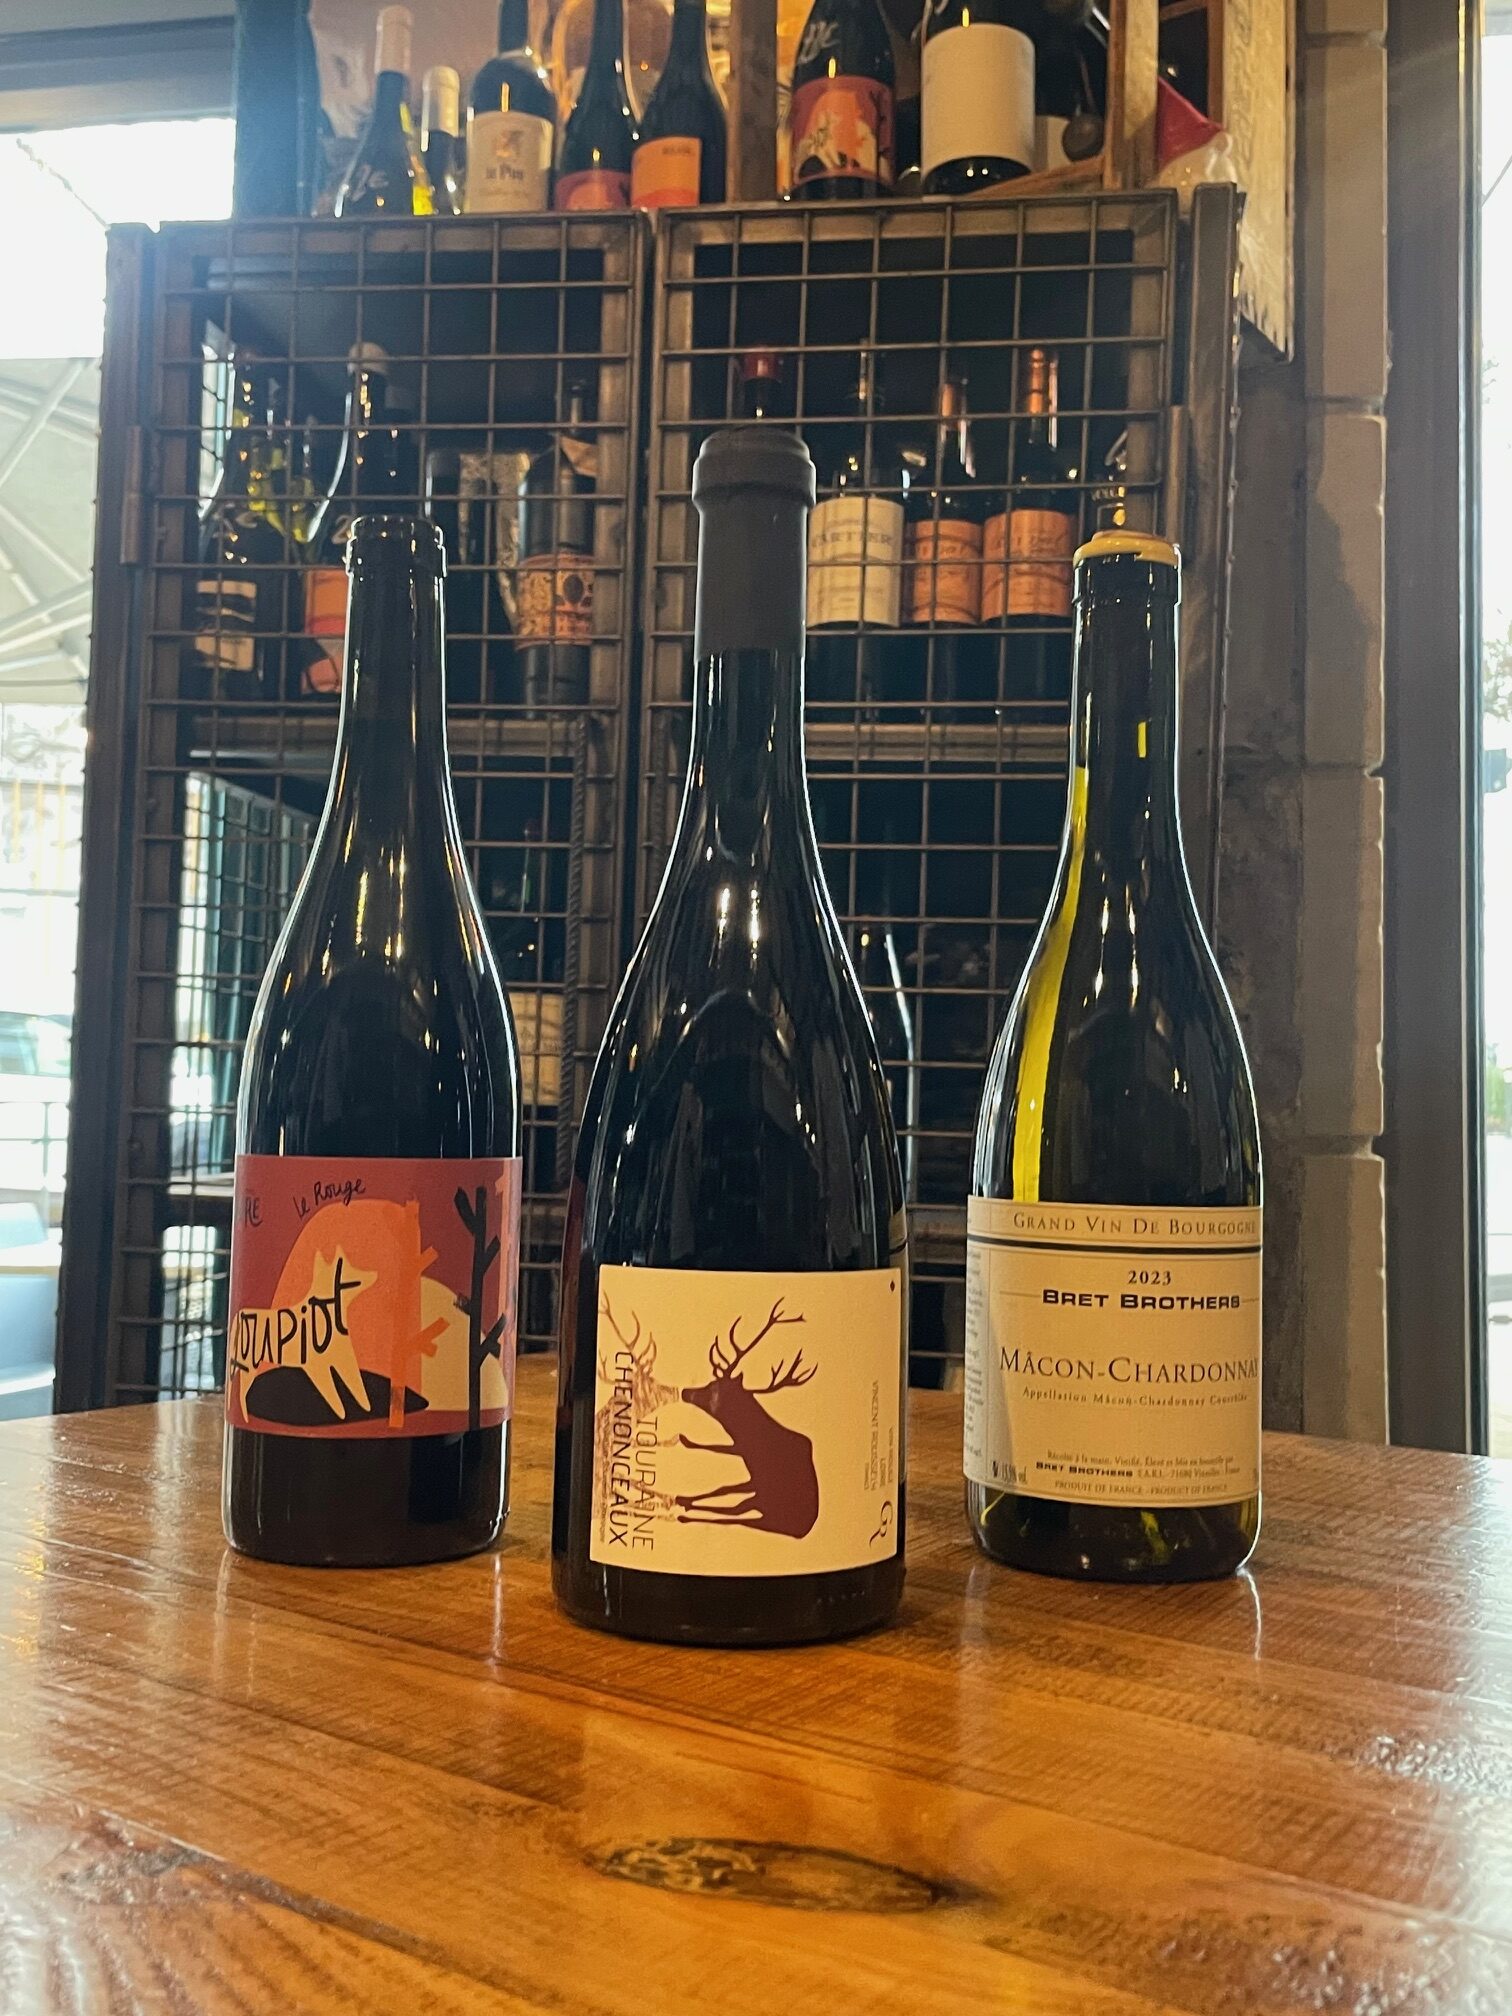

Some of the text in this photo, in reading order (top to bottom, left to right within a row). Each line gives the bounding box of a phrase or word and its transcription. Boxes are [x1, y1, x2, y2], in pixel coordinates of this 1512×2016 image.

[314, 1179, 366, 1206] Rouge
[1013, 1211, 1076, 1231] GRAND
[1086, 1215, 1122, 1234] VIN
[1127, 1270, 1172, 1286] 2023
[1043, 1289, 1240, 1310] BRET BROTHERS
[608, 1351, 634, 1547] CHENONCEAUX
[632, 1417, 658, 1550] TOURAINE
